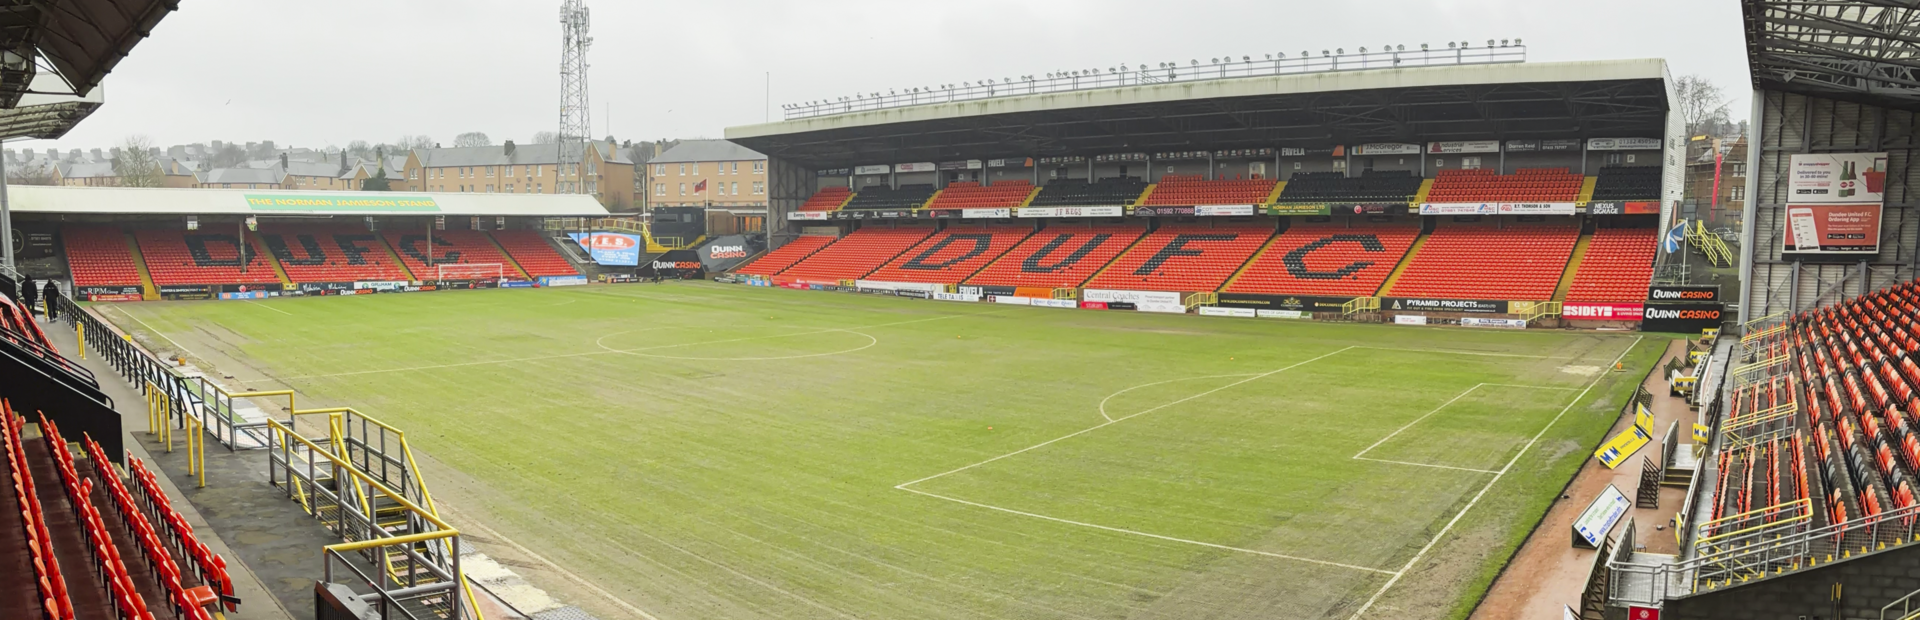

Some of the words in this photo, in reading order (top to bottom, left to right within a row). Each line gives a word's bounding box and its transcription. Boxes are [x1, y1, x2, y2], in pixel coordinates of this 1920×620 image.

[712, 245, 743, 253] QUINN
[1653, 290, 1713, 299] QUINNCASINO
[1570, 306, 1604, 316] SIDEY
[1646, 308, 1720, 319] QUINNCASINO
